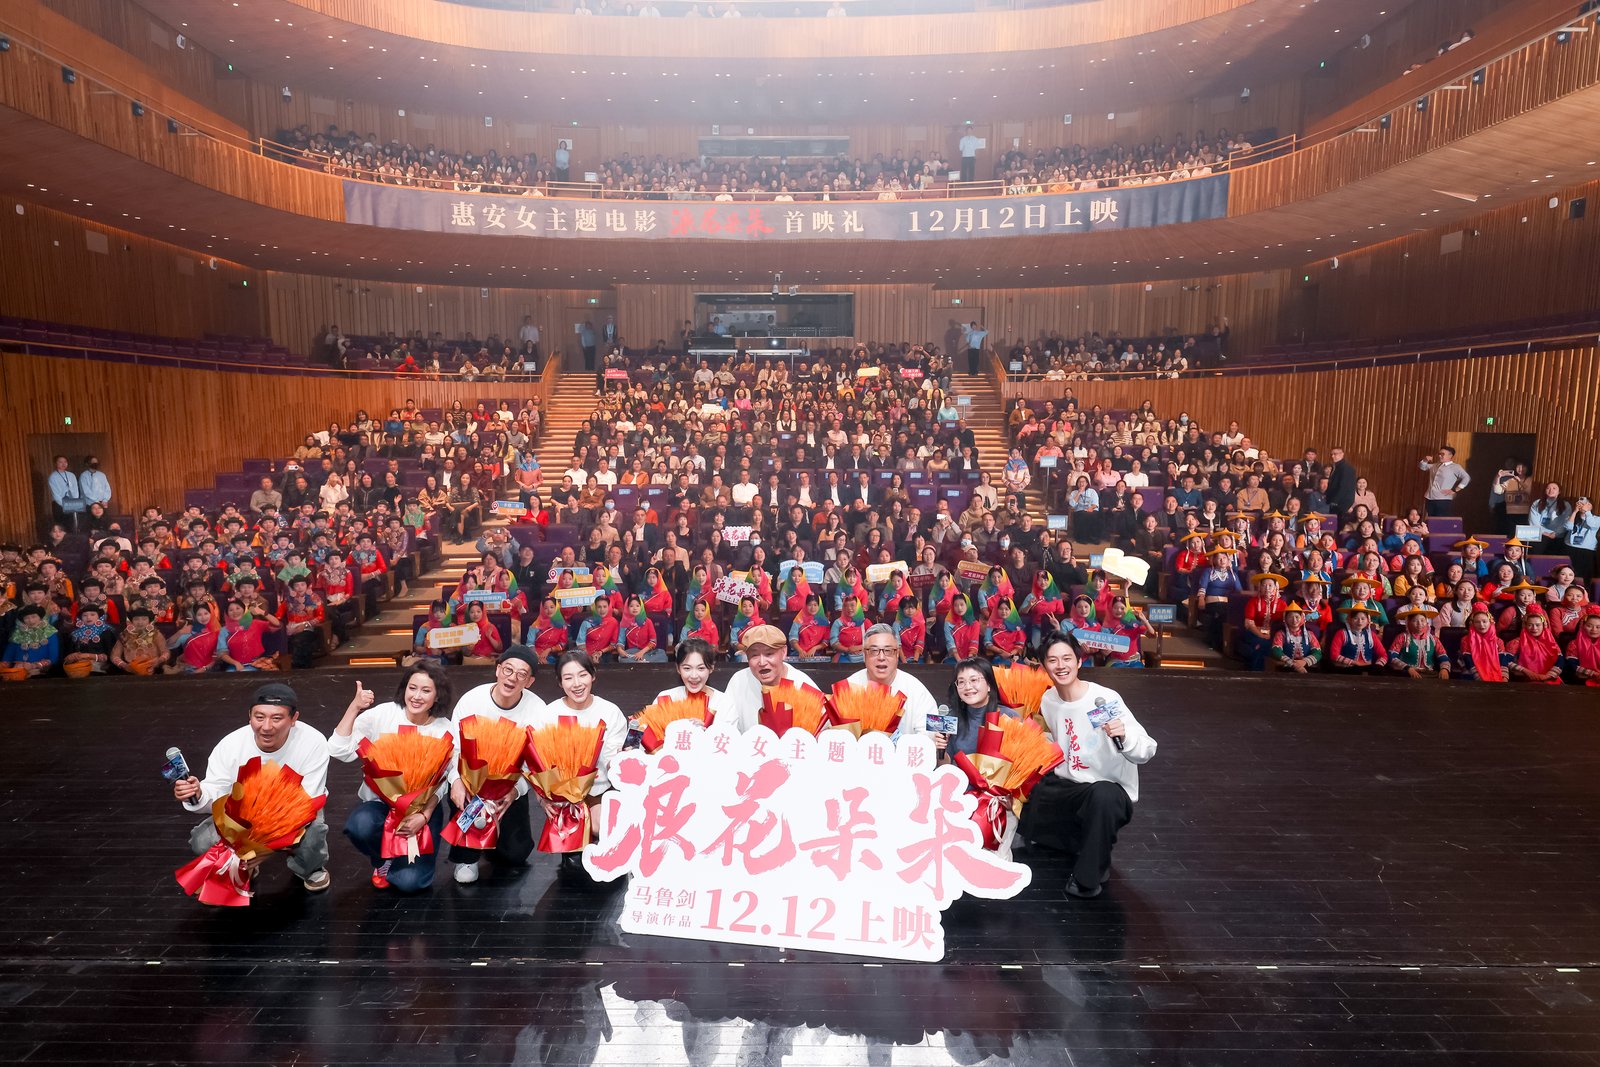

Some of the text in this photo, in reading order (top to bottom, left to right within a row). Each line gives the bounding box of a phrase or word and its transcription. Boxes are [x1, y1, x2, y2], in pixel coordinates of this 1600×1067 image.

[450, 200, 657, 233] 惠安女主题电影
[783, 209, 865, 234] 首映礼
[907, 197, 1119, 232] 12月12日上映
[674, 729, 925, 768] 惠安女主题电影
[590, 754, 1023, 901] 浪花朵朵
[632, 885, 696, 910] 马鲁剑
[631, 909, 692, 928] 导演作品
